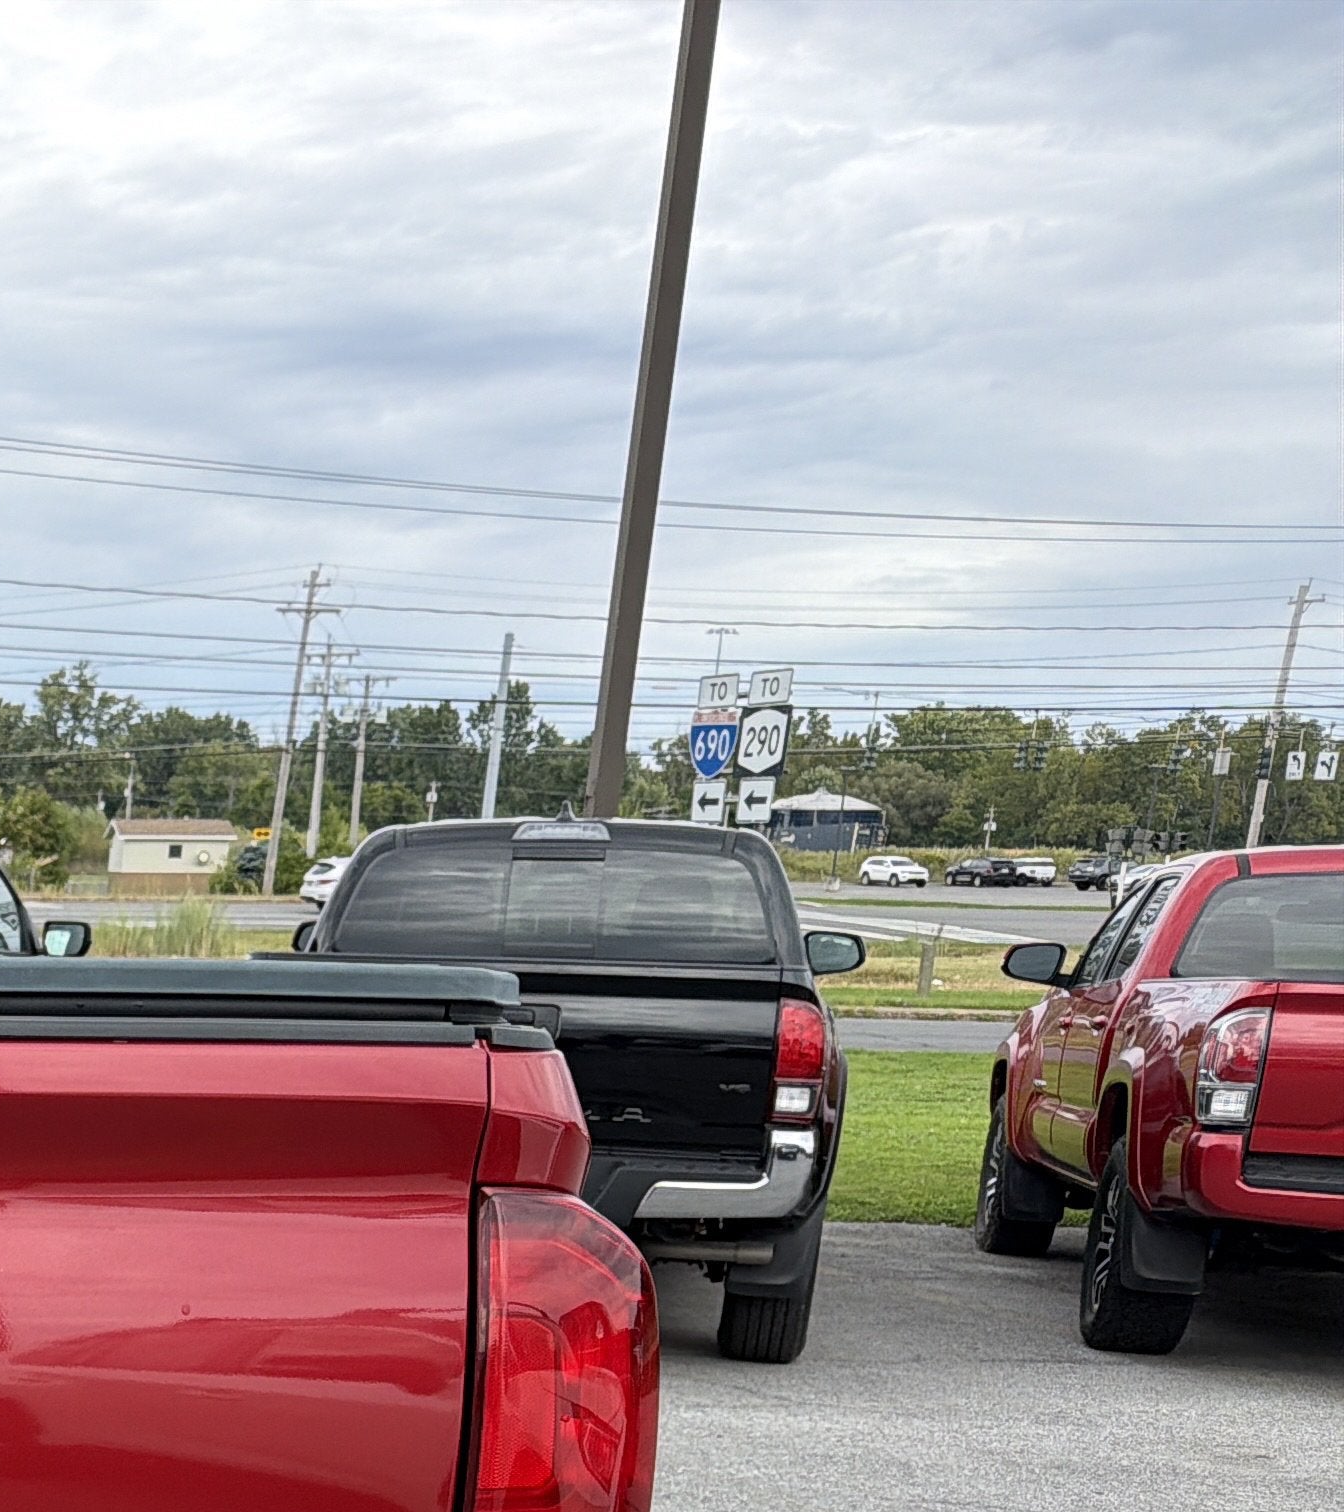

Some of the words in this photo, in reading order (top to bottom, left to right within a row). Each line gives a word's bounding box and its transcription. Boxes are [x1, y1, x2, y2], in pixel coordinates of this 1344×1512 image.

[710, 682, 728, 701] TO
[761, 677, 780, 698] TO
[694, 728, 730, 761] 690
[743, 724, 780, 758] 290
